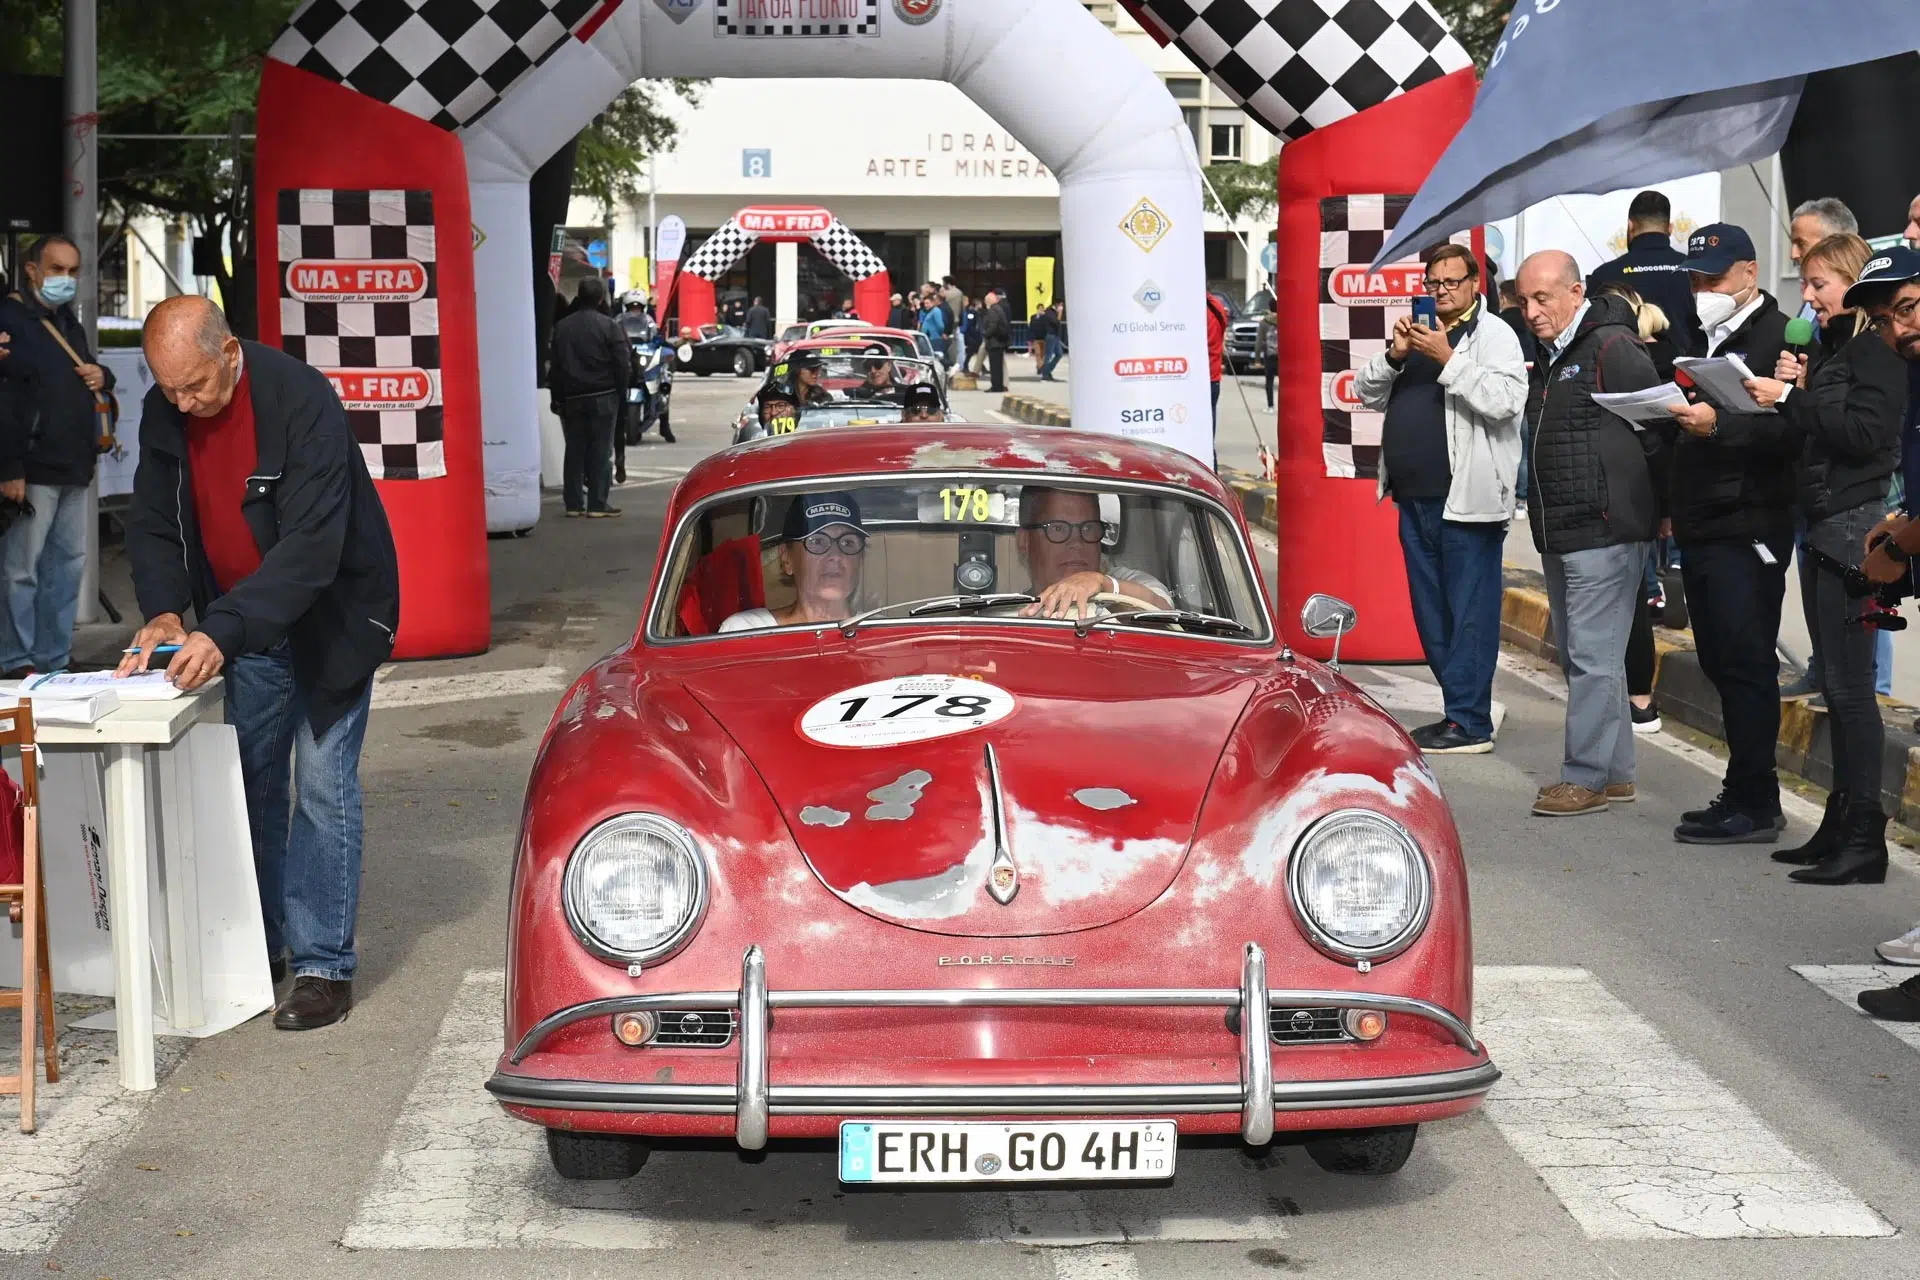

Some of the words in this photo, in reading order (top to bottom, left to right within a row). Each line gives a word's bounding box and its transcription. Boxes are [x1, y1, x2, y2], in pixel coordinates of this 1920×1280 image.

[749, 156, 764, 178] 8
[866, 159, 928, 177] ARTE
[955, 159, 1048, 178] MINERA
[745, 215, 776, 230] MA
[785, 215, 825, 230] FRA
[297, 269, 340, 290] MA
[357, 269, 415, 290] FRA
[1342, 274, 1388, 294] MA
[343, 294, 356, 302] per
[1353, 297, 1389, 305] cosmetici
[1390, 297, 1403, 306] per
[1129, 322, 1158, 333] Global
[1118, 362, 1146, 374] MA
[1153, 360, 1185, 373] FRA
[362, 377, 420, 398] FRA
[348, 402, 362, 410] per
[1121, 407, 1164, 423] sara
[771, 416, 796, 436] 179
[810, 506, 826, 515] MA
[829, 505, 848, 514] FRA
[939, 488, 989, 521] 178
[840, 694, 992, 722] 178
[938, 956, 1076, 966] PORSCHE
[878, 1132, 968, 1173] ERH
[1008, 1132, 1066, 1172] GO
[1081, 1131, 1139, 1170] 4H
